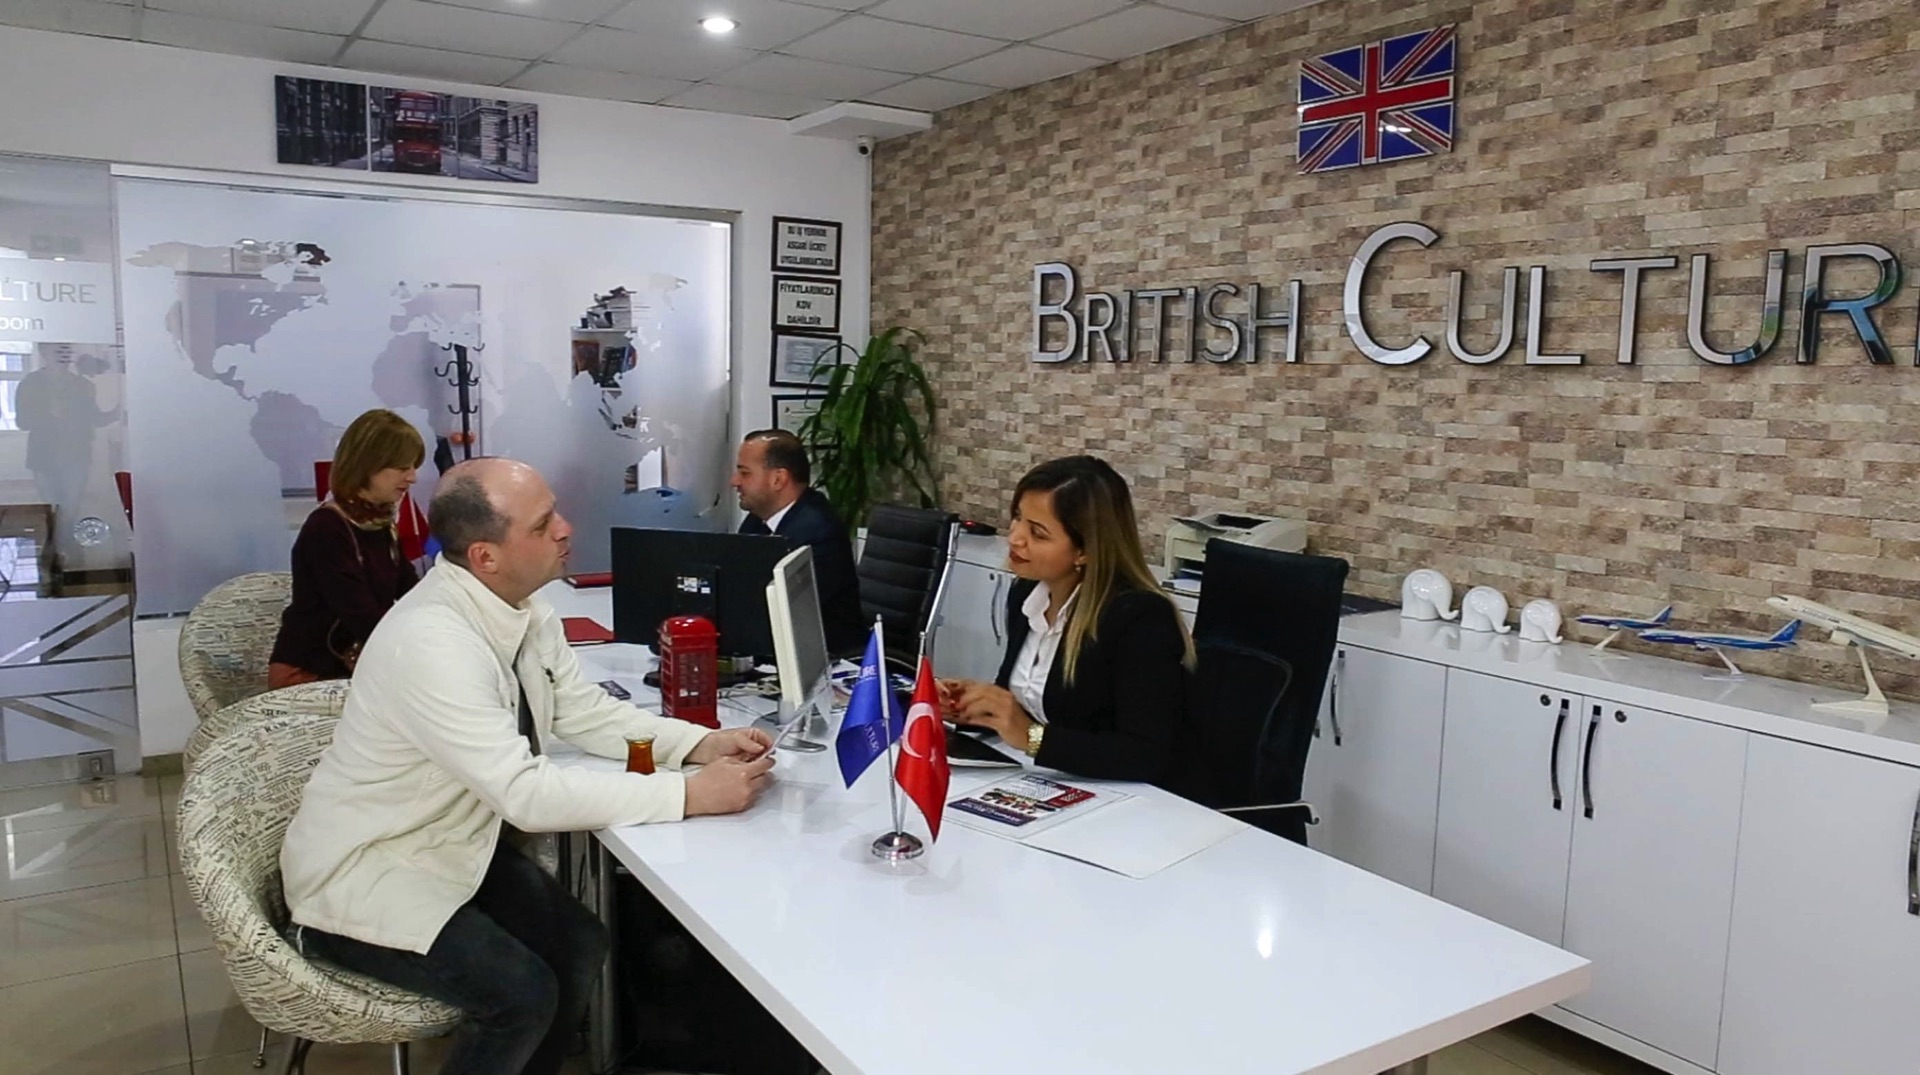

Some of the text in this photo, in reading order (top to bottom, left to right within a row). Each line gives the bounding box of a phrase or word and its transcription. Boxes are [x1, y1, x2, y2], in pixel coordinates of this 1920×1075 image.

[796, 300, 811, 310] KDV
[1032, 221, 1920, 366] BRITISH CULTUR
